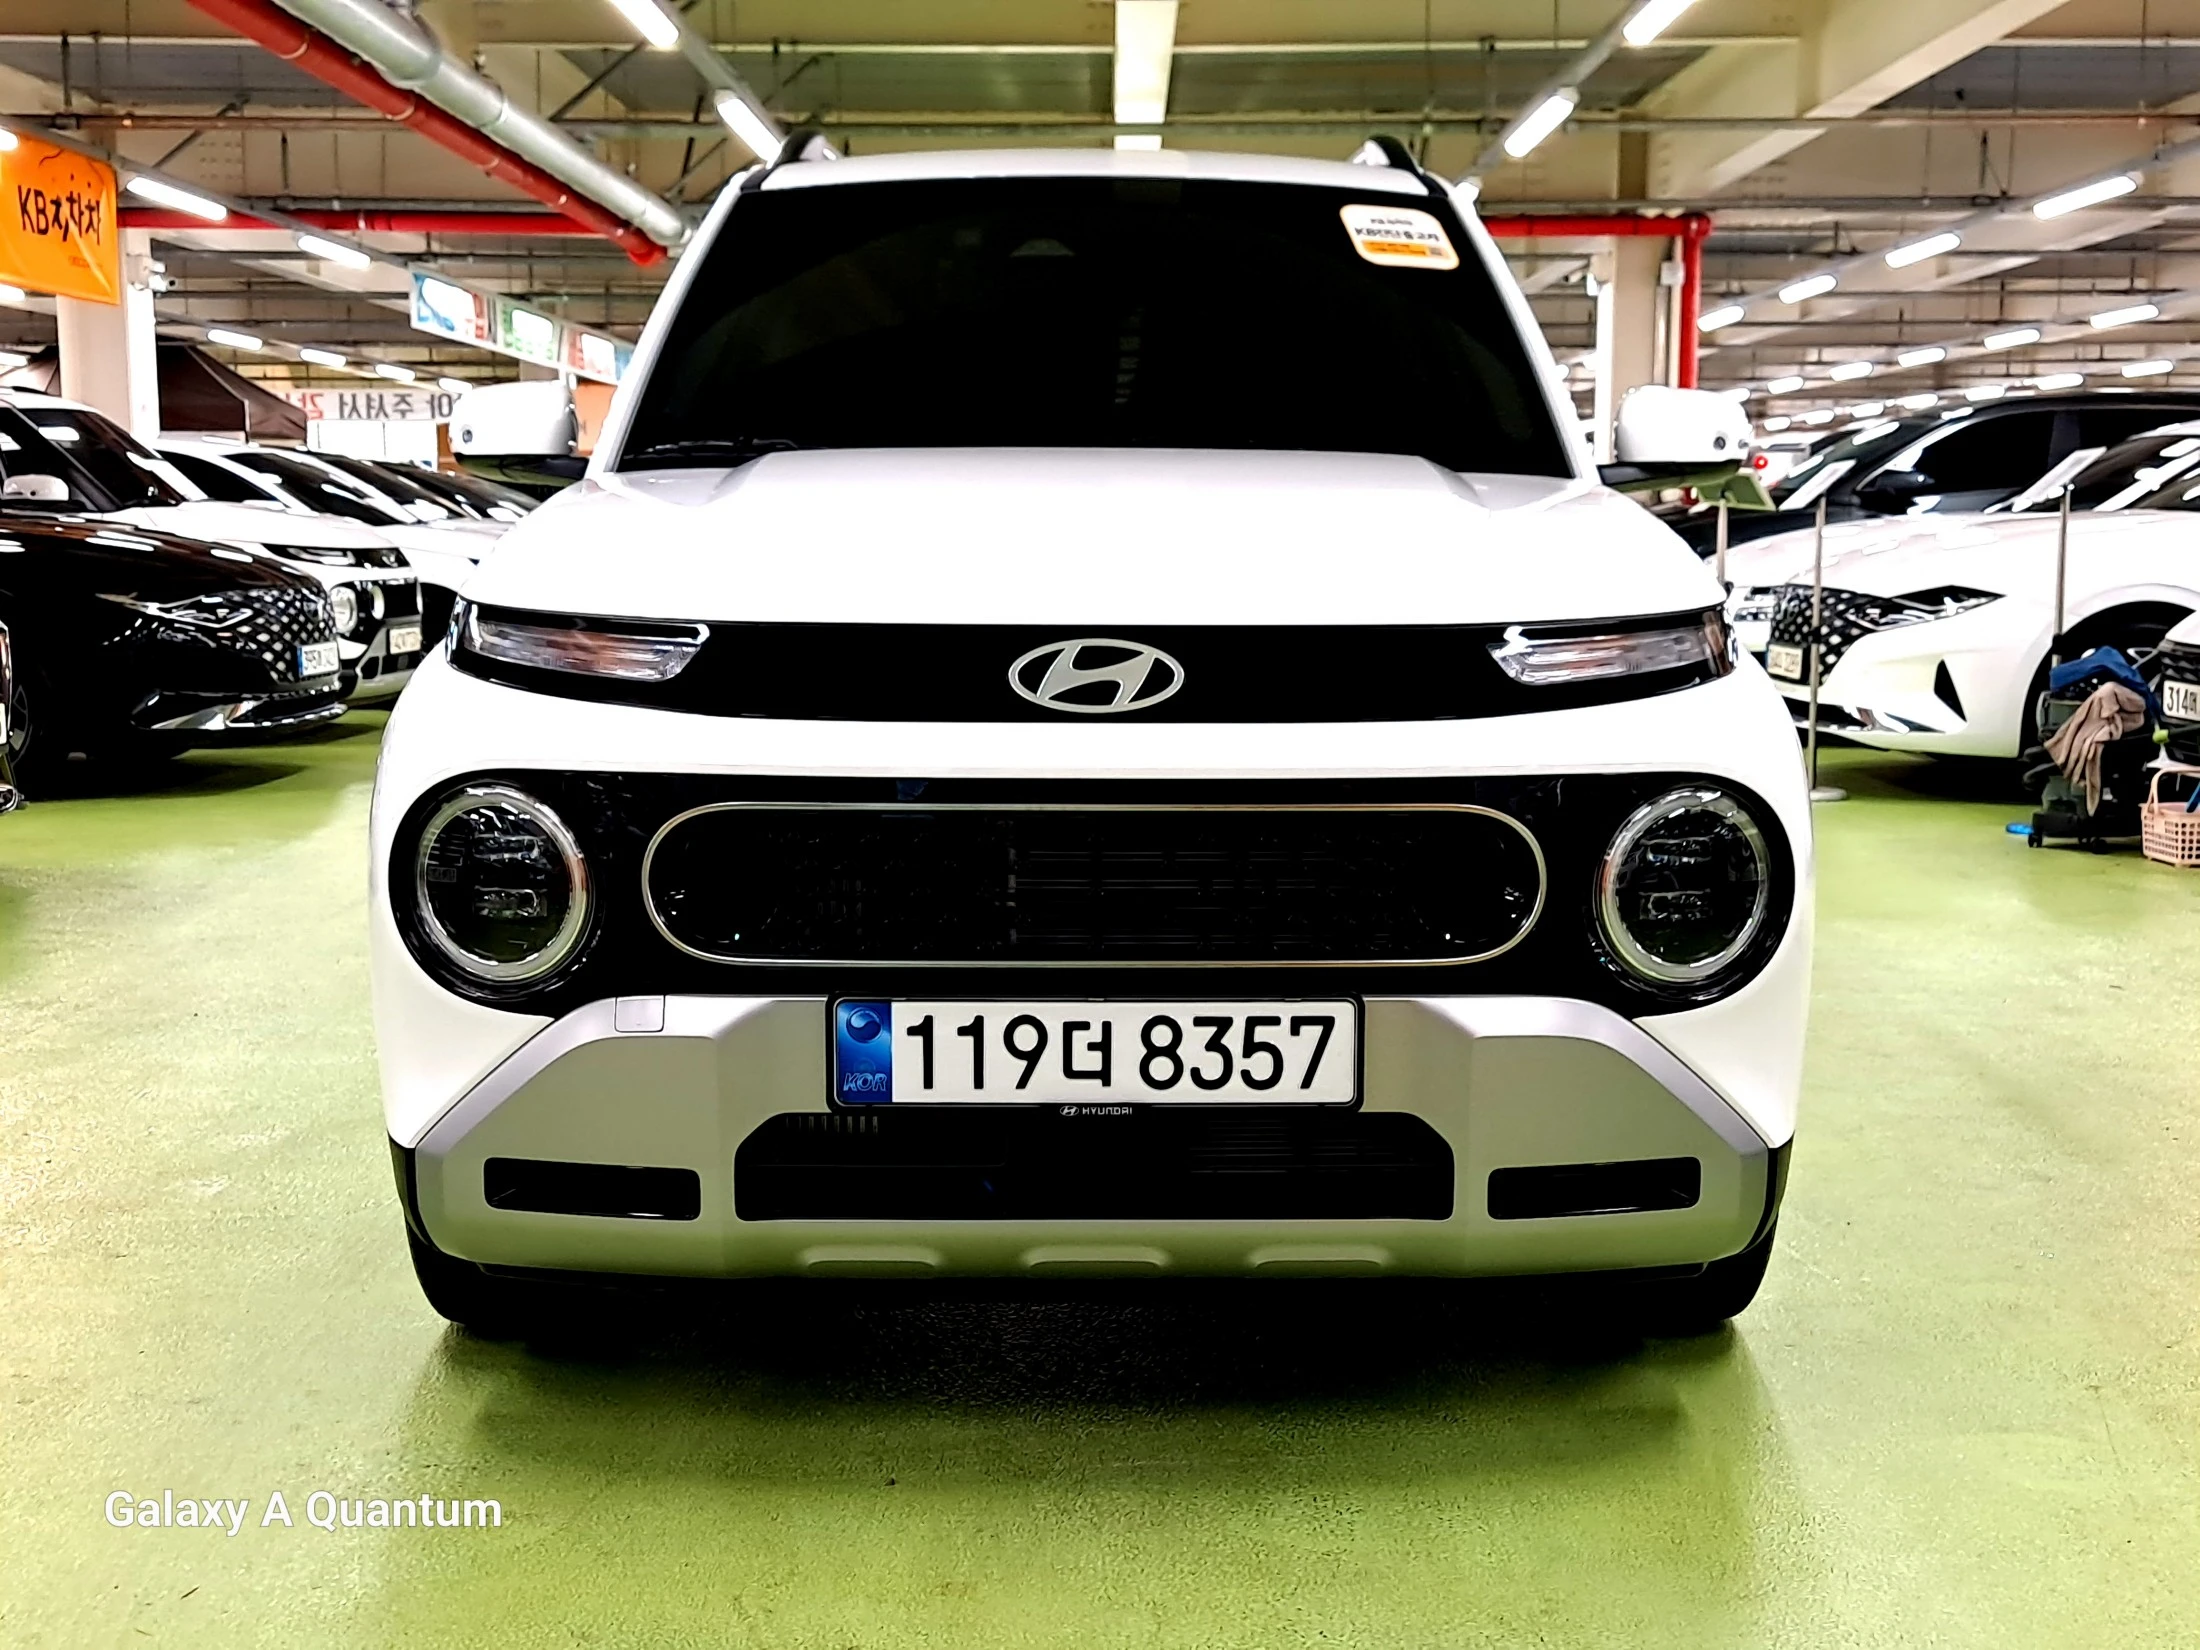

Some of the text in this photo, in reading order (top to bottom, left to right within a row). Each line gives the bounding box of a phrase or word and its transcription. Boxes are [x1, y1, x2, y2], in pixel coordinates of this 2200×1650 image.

[906, 1014, 1336, 1090] 119더 8357
[843, 1072, 887, 1092] KOR
[1082, 1106, 1133, 1116] HYUNDAI
